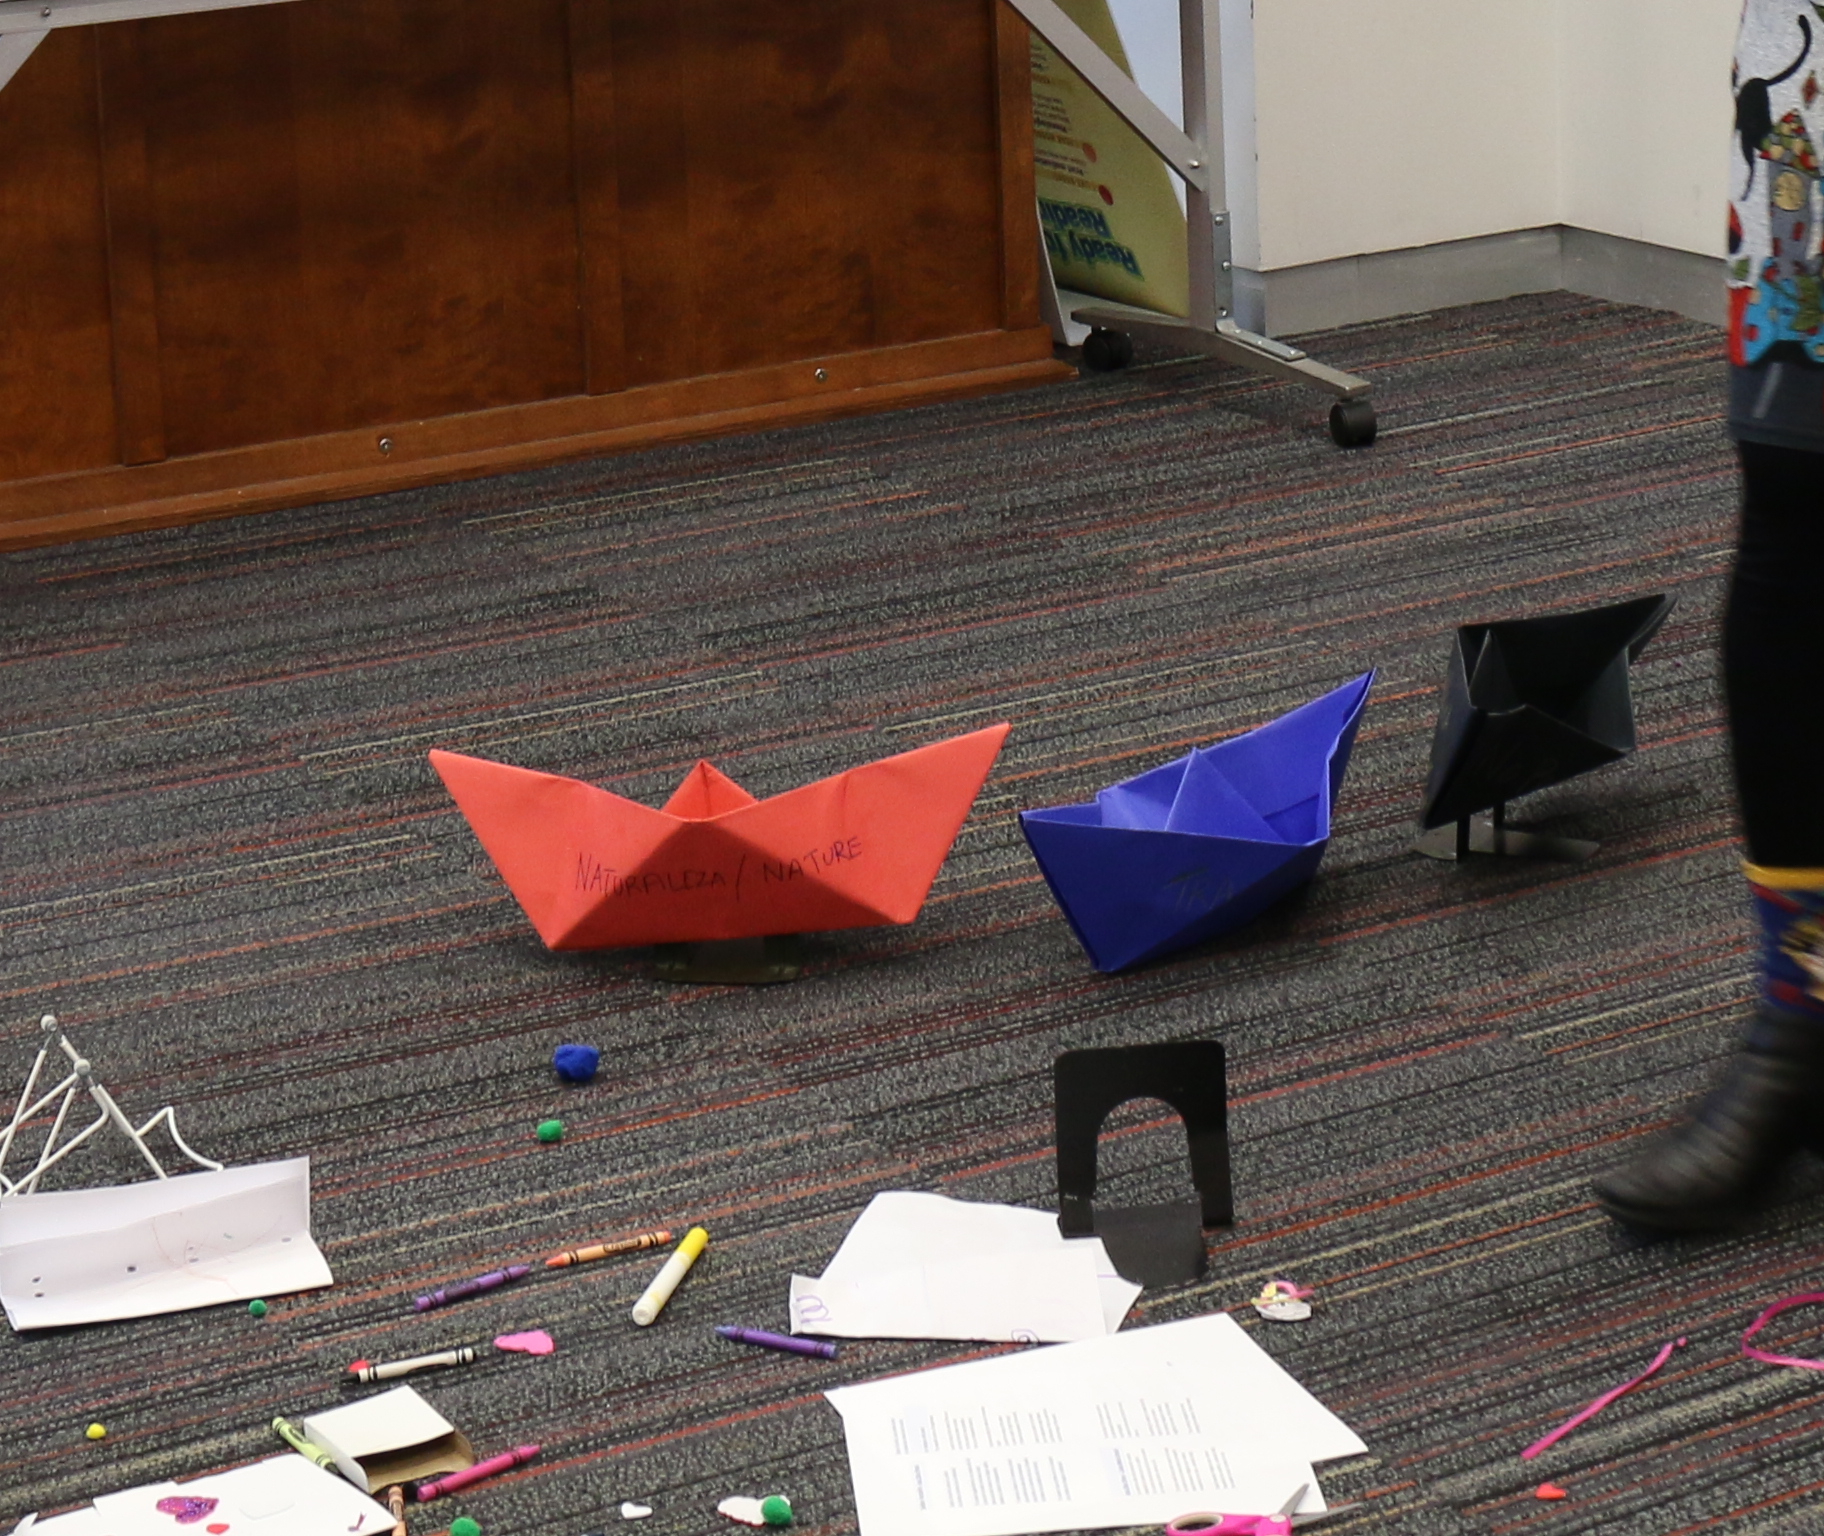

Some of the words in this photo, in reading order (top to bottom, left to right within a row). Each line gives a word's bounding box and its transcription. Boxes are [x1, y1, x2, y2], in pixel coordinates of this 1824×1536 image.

[1069, 230, 1141, 277] Ready
[573, 850, 727, 899] NATURALEZA
[762, 836, 864, 884] NATURE
